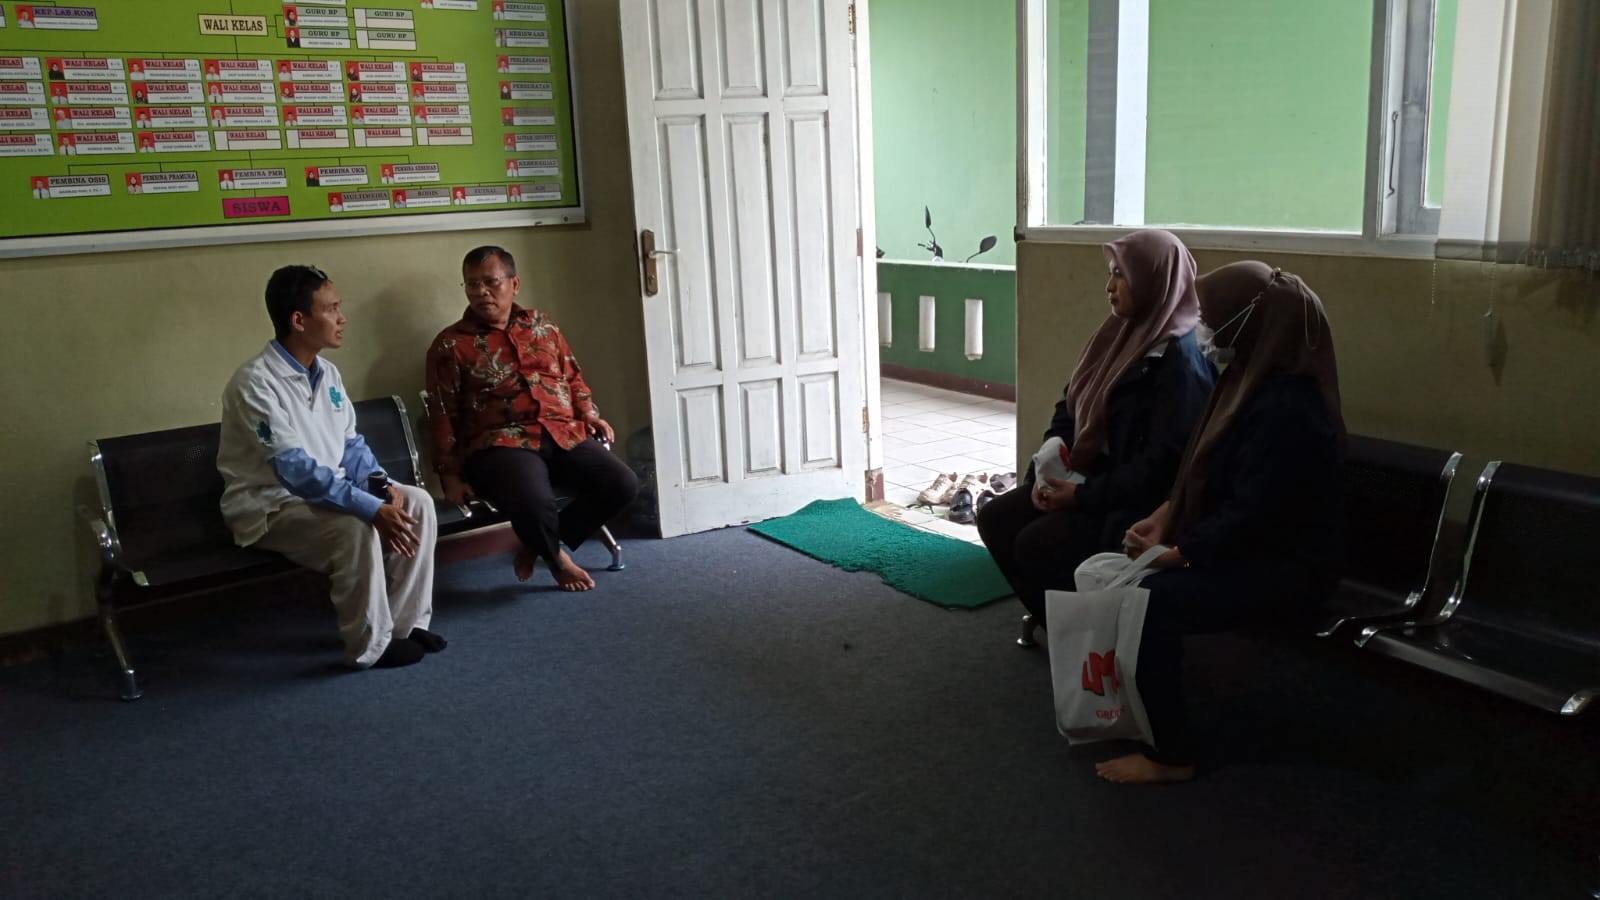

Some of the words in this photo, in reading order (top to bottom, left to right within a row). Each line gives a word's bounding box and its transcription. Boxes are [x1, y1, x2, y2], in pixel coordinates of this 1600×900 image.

[74, 9, 94, 17] KOM
[203, 19, 229, 31] WALI
[231, 20, 264, 32] KELAS
[10, 135, 33, 143] KELAS
[168, 173, 195, 181] PRAMUKA
[234, 170, 266, 178] PEMBINA
[50, 177, 86, 185] PEMBINA
[343, 192, 388, 201] MULTIMEDIA
[232, 201, 281, 213] SISWA
